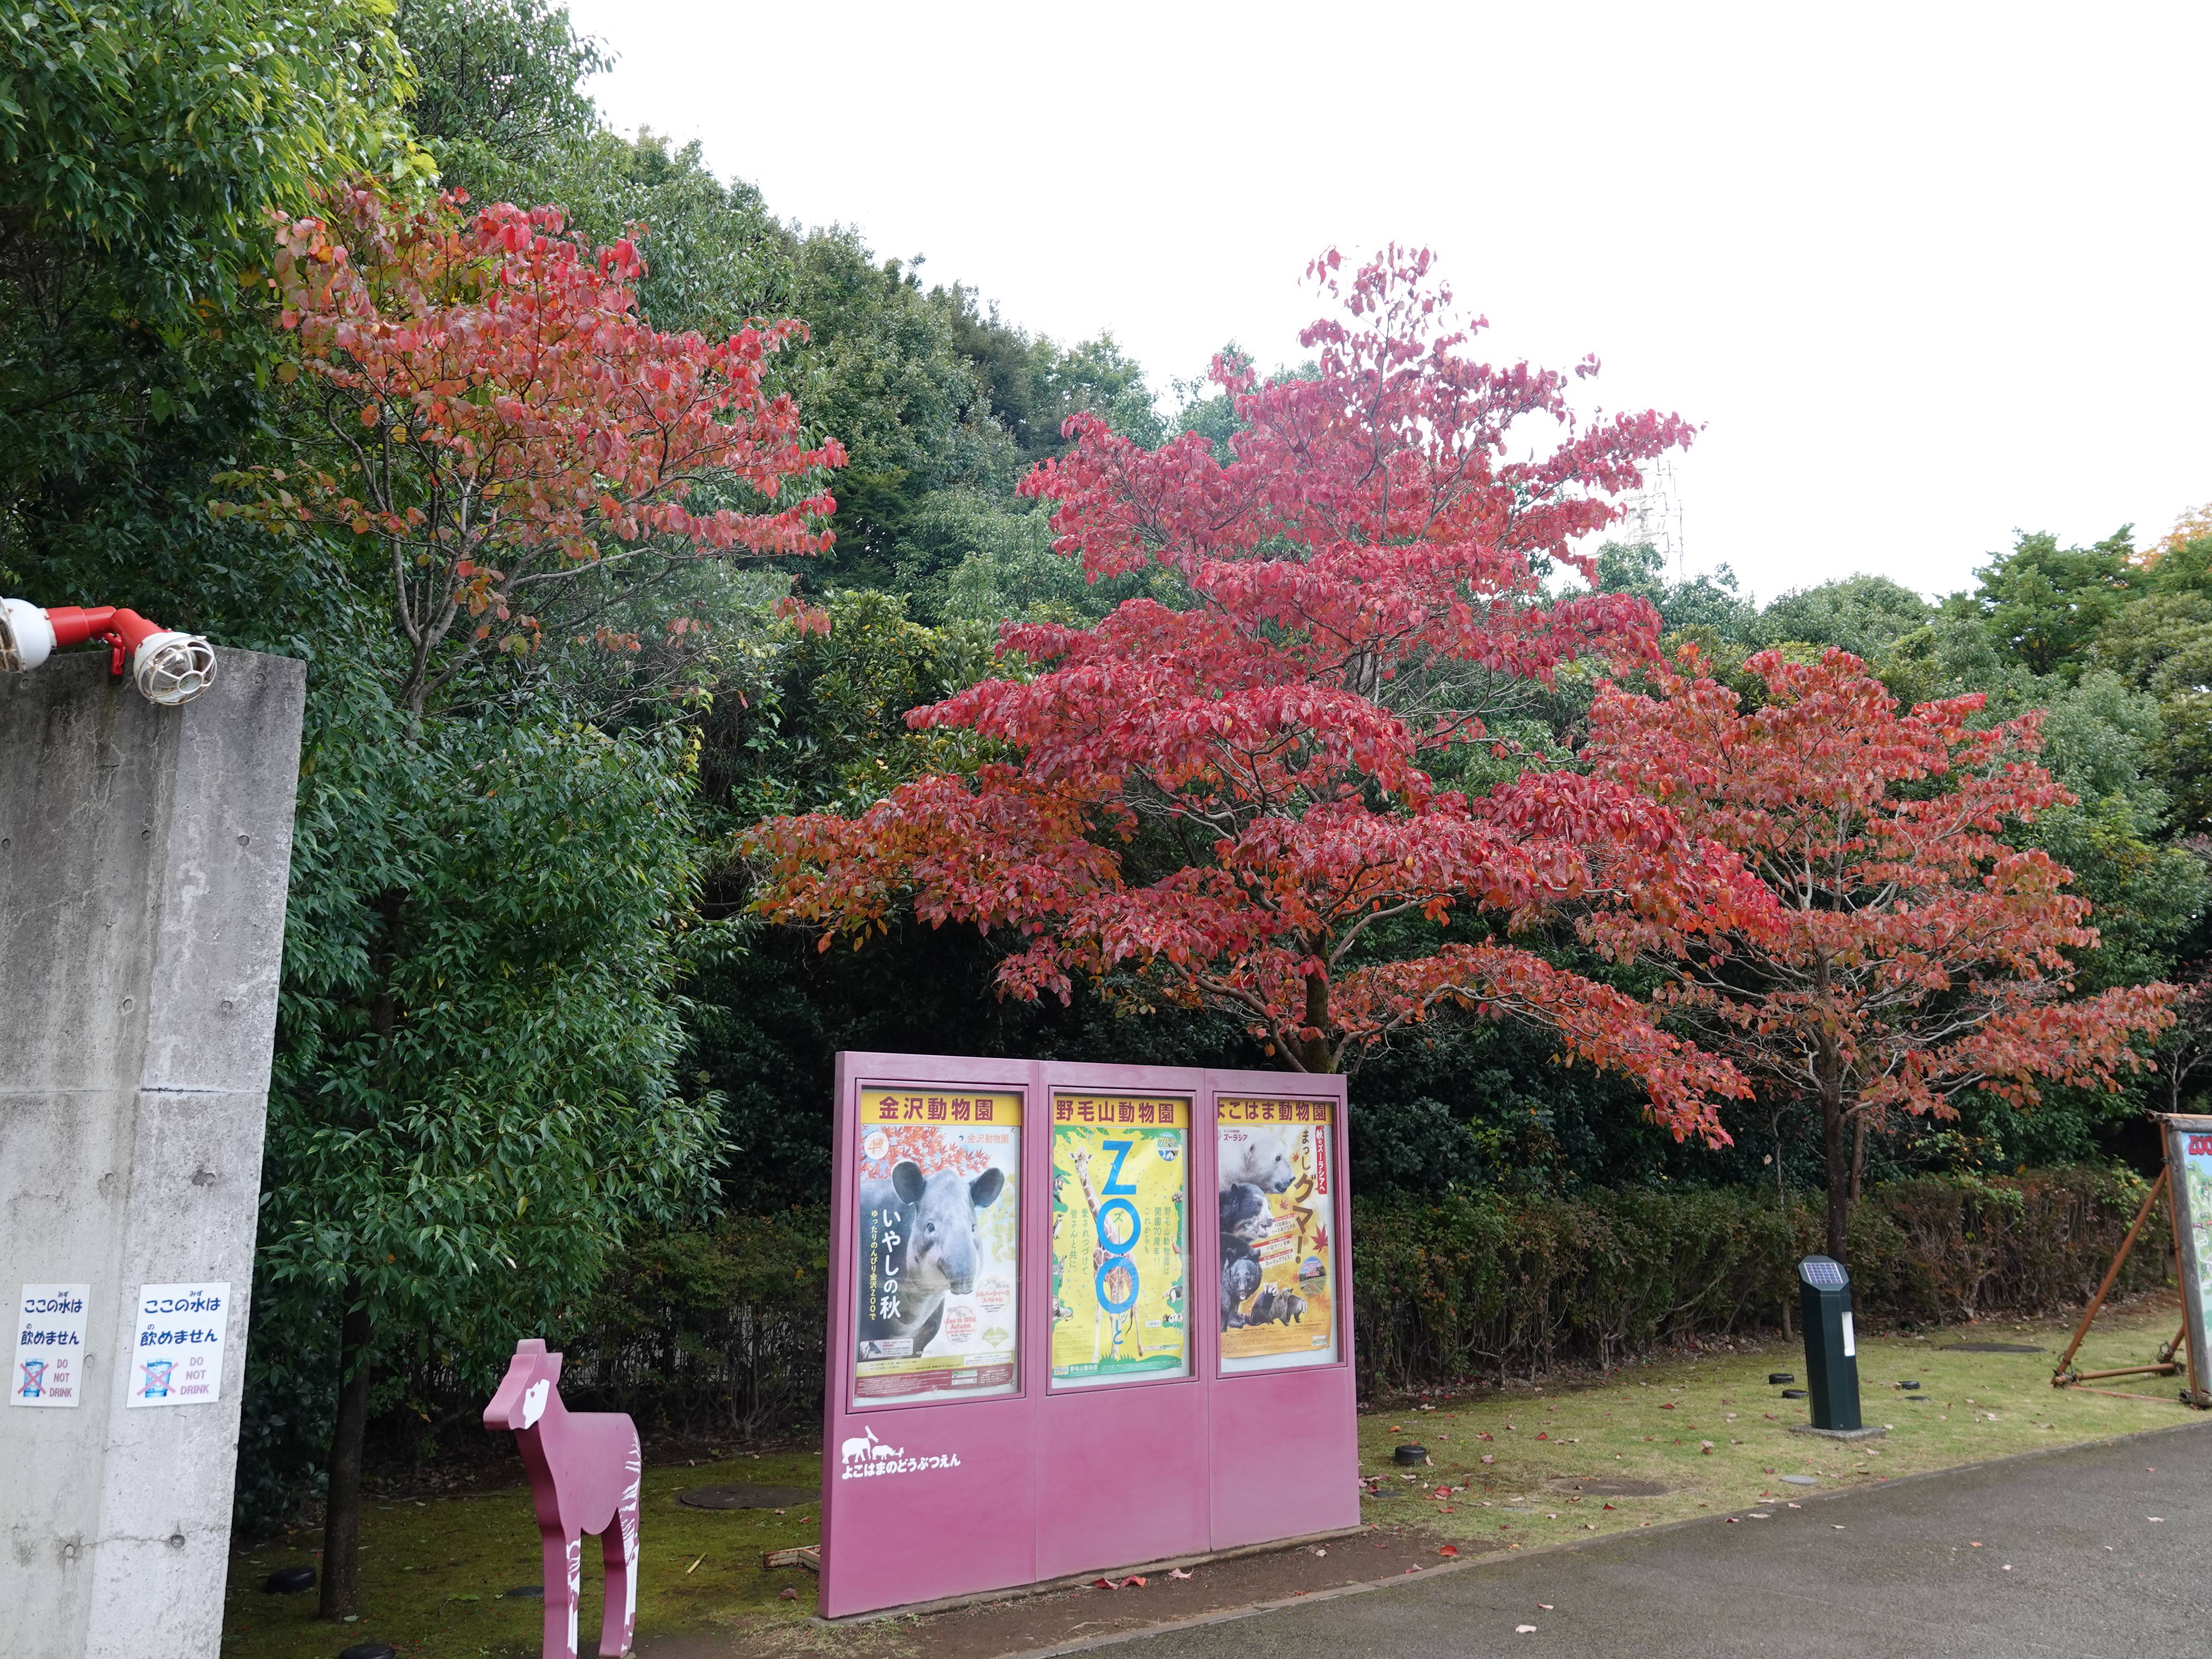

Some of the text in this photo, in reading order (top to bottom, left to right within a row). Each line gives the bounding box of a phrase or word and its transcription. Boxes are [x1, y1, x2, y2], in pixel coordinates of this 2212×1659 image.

[879, 1096, 993, 1121] 金沢動物園
[1056, 1100, 1174, 1124] 野毛山動物園
[967, 1134, 1009, 1144] 金沢動物園
[1163, 1207, 1171, 1275] 野毛山動物園は
[869, 1210, 878, 1321] ゆったりのんびり金沢ZOOで
[880, 1209, 901, 1320] いやしの秋
[24, 1299, 83, 1314] ここの水は
[144, 1297, 221, 1314] ここの水は
[20, 1330, 80, 1346] 飲めません
[140, 1328, 218, 1347] 飲めません
[57, 1359, 68, 1368] DO
[190, 1357, 204, 1367] DO
[54, 1372, 70, 1382] NOT
[186, 1370, 207, 1380] NOT
[49, 1387, 72, 1398] DRINK
[180, 1384, 209, 1395] DRINK
[842, 1453, 961, 1480] よこはまのどうぶつえん
